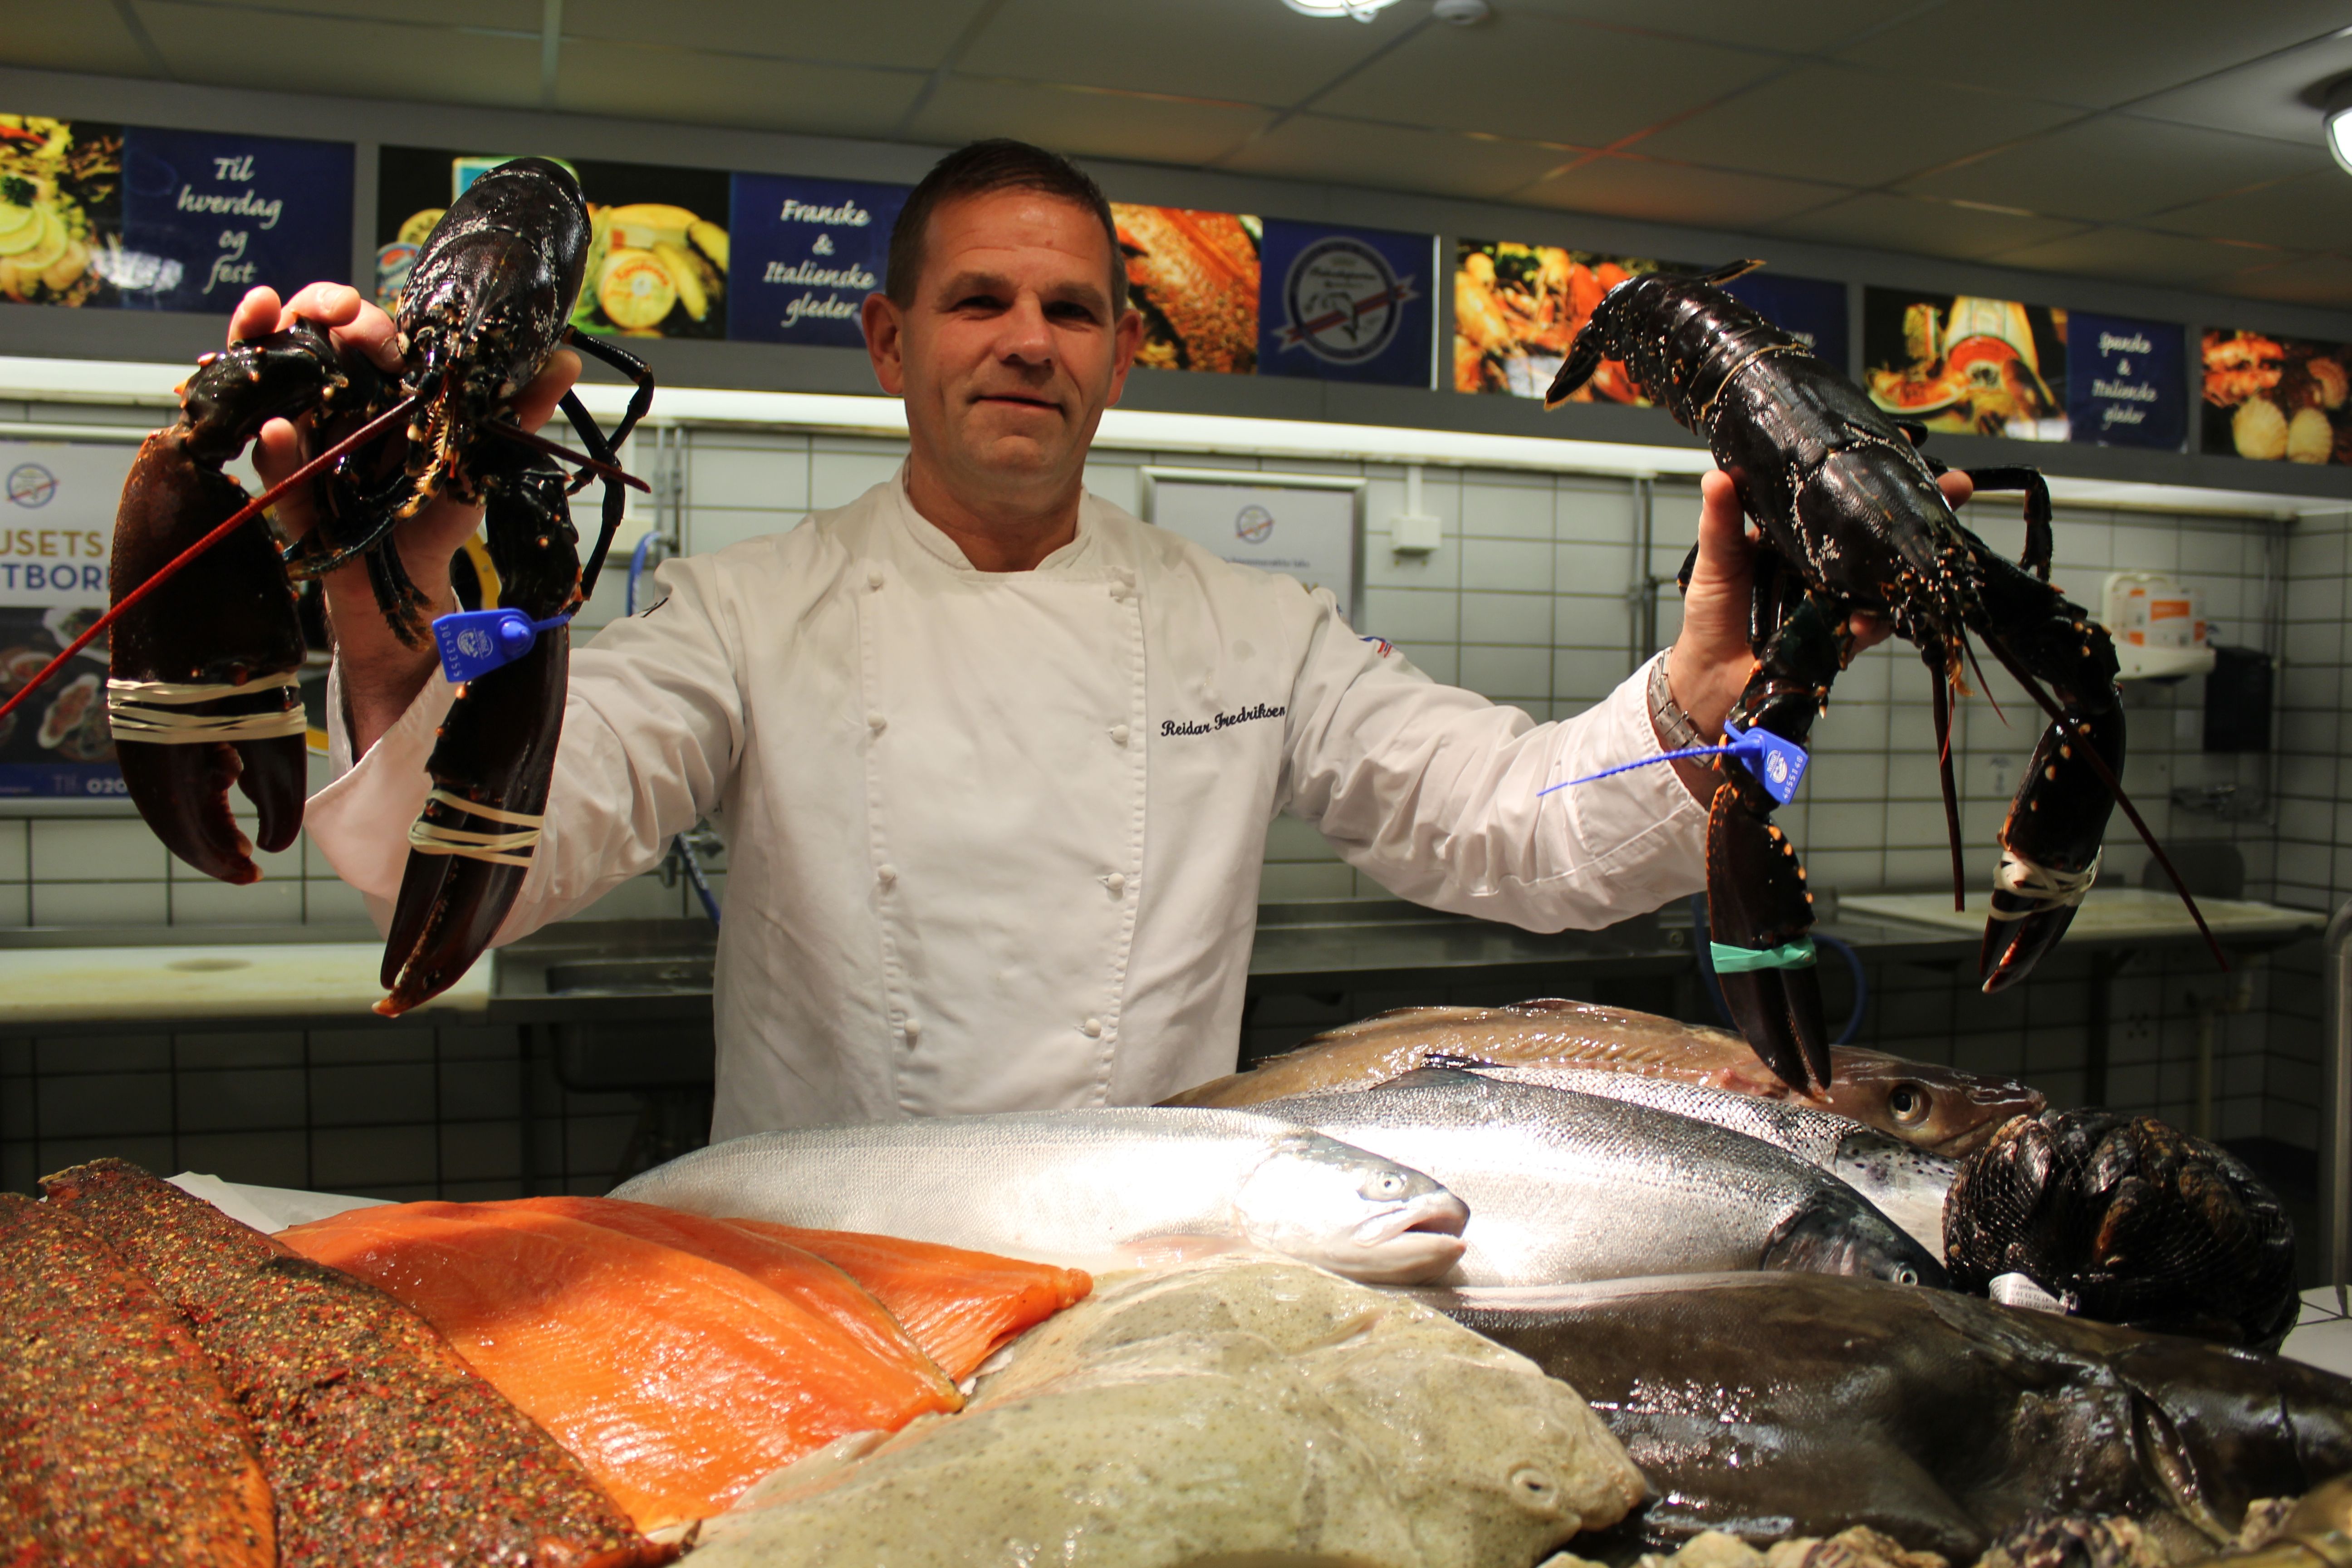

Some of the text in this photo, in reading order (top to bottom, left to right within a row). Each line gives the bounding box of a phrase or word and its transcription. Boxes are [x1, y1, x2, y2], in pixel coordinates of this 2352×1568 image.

[214, 155, 255, 181] Til
[177, 184, 283, 230] hverdag
[780, 199, 872, 227] Franske
[219, 230, 249, 261] og
[812, 233, 835, 256] &
[202, 255, 258, 294] fest
[762, 259, 878, 289] Italienske
[780, 291, 858, 328] gleder
[2117, 358, 2132, 376] &
[2091, 379, 2158, 402] Italienske
[2100, 402, 2146, 431] gleder
[1, 564, 112, 590] TBOR
[1161, 703, 1286, 736] Reidar Fredriksen
